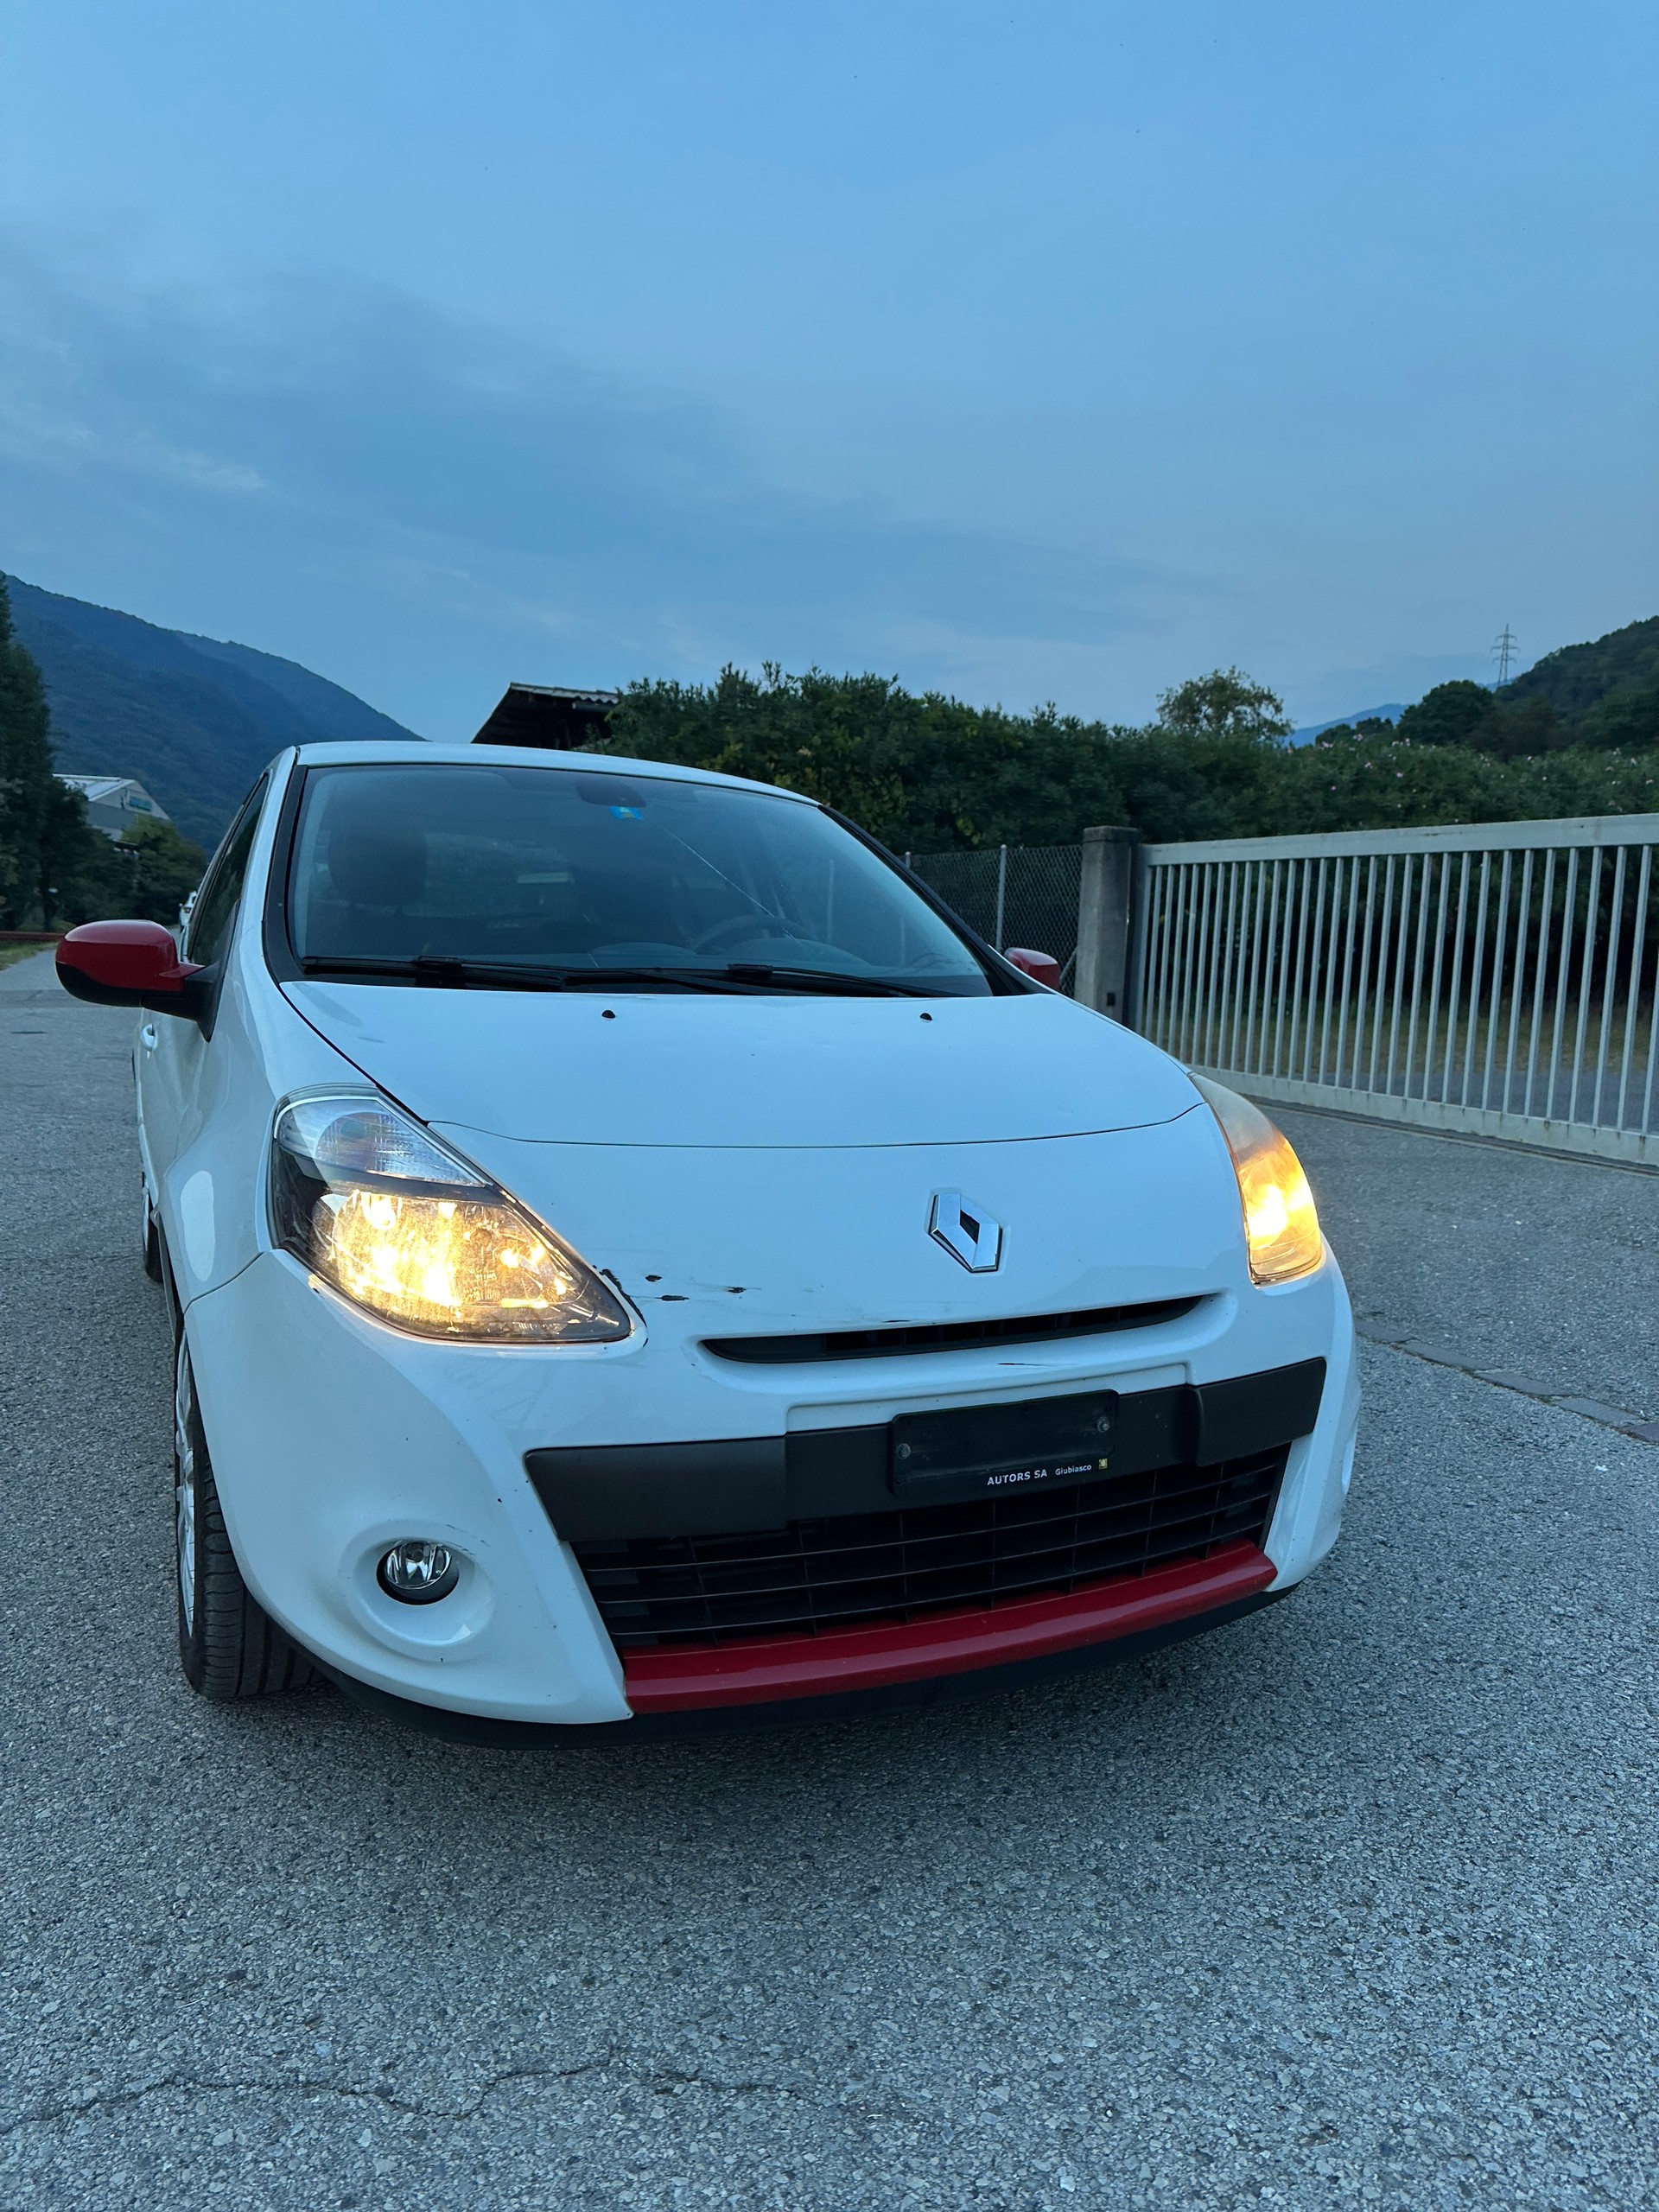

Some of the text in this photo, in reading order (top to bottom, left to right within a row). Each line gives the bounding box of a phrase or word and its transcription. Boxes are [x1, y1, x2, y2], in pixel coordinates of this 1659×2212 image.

[987, 1464, 1092, 1486] AUTORS SA Giubiasco
